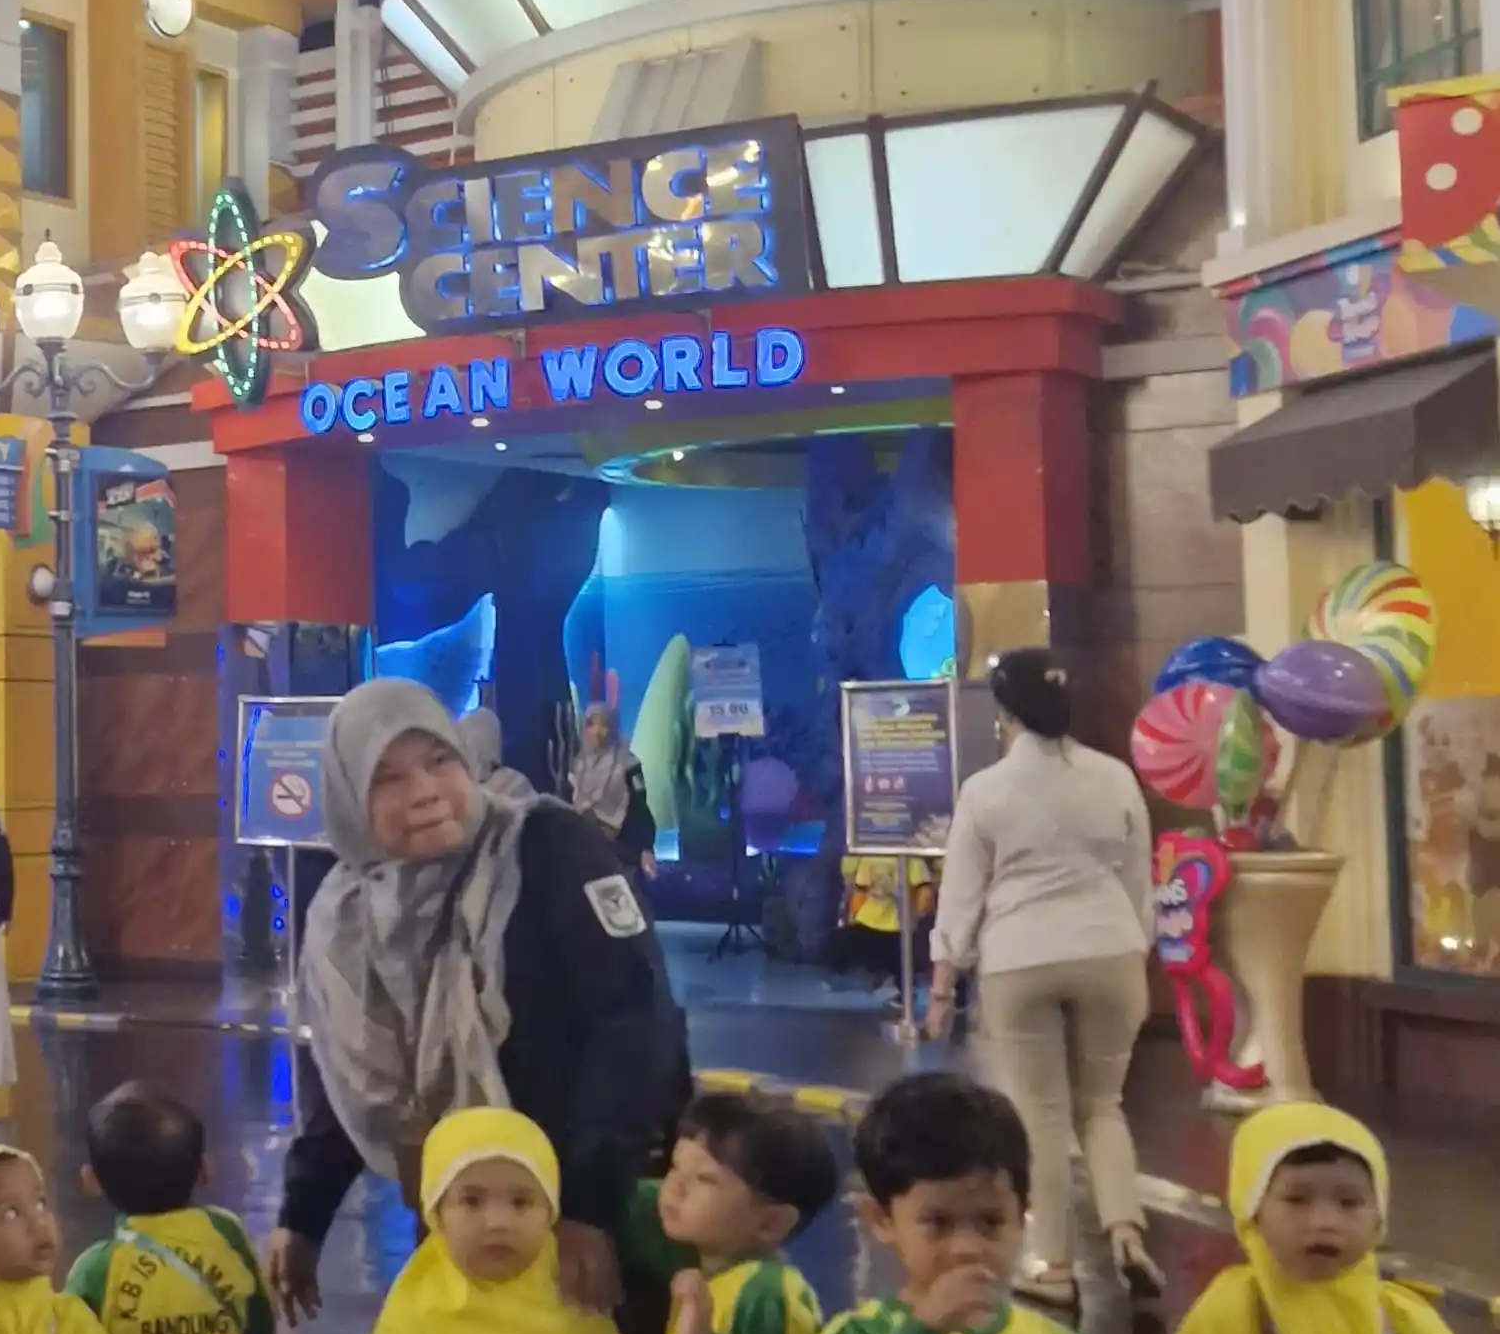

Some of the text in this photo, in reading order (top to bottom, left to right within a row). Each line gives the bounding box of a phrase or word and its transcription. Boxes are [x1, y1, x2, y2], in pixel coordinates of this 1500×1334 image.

[315, 138, 773, 270] SCIENCE
[405, 220, 779, 321] CENTER
[301, 327, 804, 435] OCEAN WORLD
